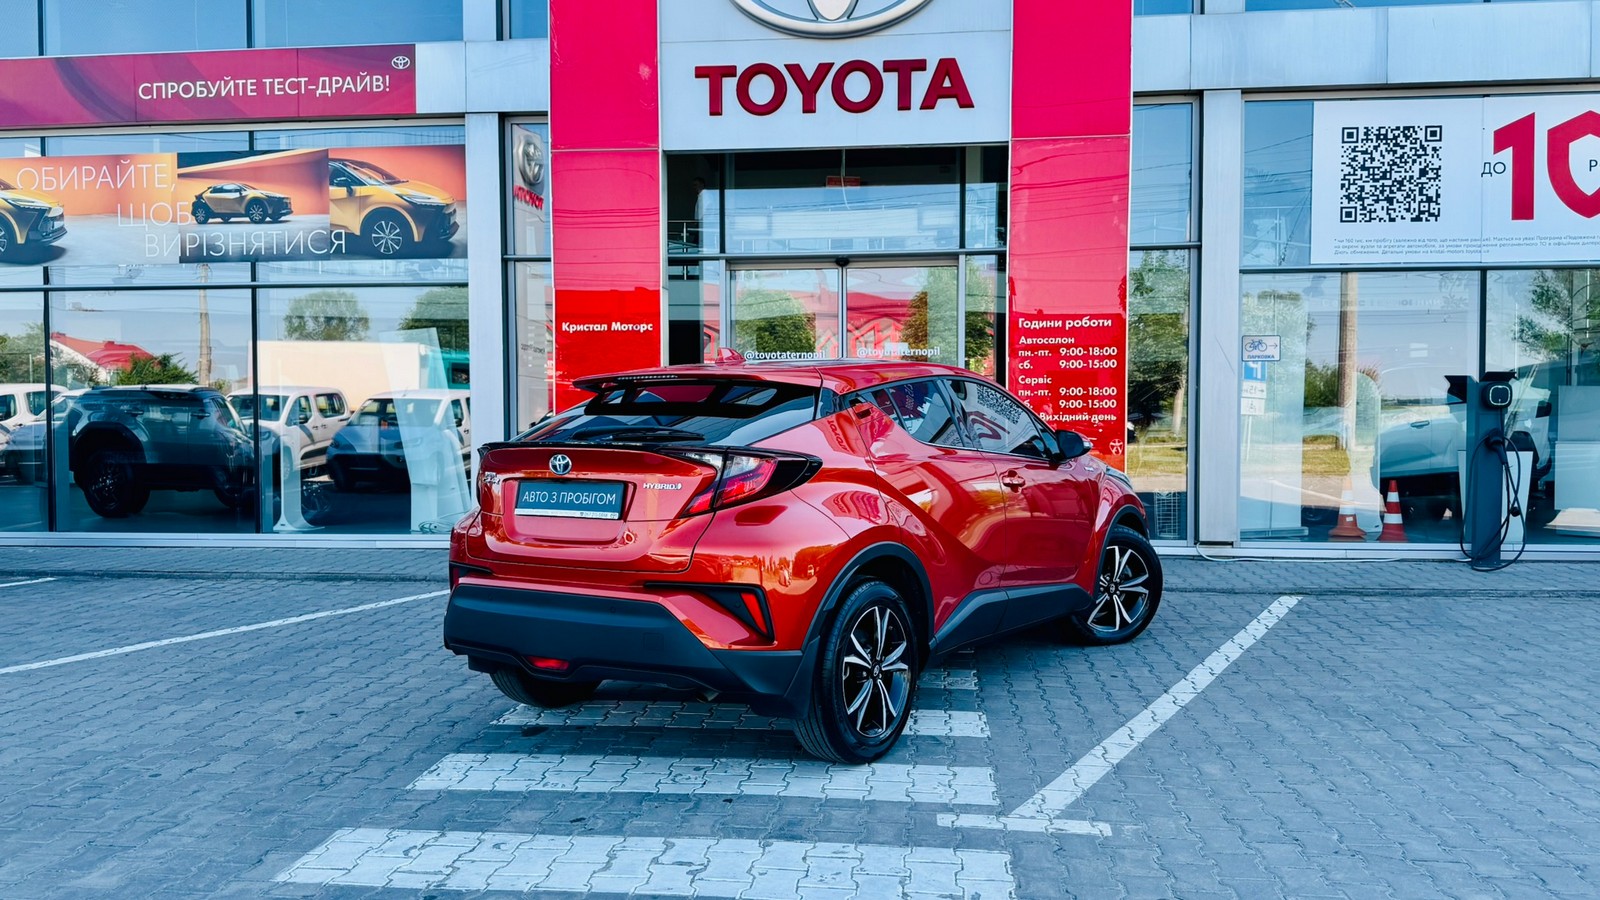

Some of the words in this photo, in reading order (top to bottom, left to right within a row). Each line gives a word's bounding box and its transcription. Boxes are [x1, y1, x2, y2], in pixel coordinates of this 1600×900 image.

[138, 76, 257, 100] СПРОБУЙТЕ
[262, 71, 390, 97] ТЕСТ-ДРАЙВ!
[694, 57, 975, 116] TOYOTA
[16, 159, 176, 192] ОБИРАЙТЕ,
[1481, 161, 1506, 178] ДО
[117, 201, 192, 230] ЩОБ
[145, 229, 346, 258] ВИРІЗНЯТИСЯ
[562, 322, 608, 334] Кристал
[611, 322, 653, 332] Моторс
[1018, 318, 1062, 330] Години
[1066, 316, 1112, 330] роботи
[1019, 336, 1074, 344] Автосалон
[744, 350, 826, 360] @toyotaternopil
[1060, 347, 1118, 356] 9:00-18:00
[1018, 360, 1033, 369] сб.
[1060, 360, 1118, 368] 9:00-15:00
[1018, 375, 1052, 386] Сервіс
[1060, 387, 1118, 396] 9:00-18:00
[1060, 400, 1118, 408] 9:00-15:00
[1040, 412, 1088, 422] Вихідний
[1091, 414, 1117, 423] день
[522, 491, 548, 503] АВТО
[560, 492, 616, 505] ПРОБІГОМ
